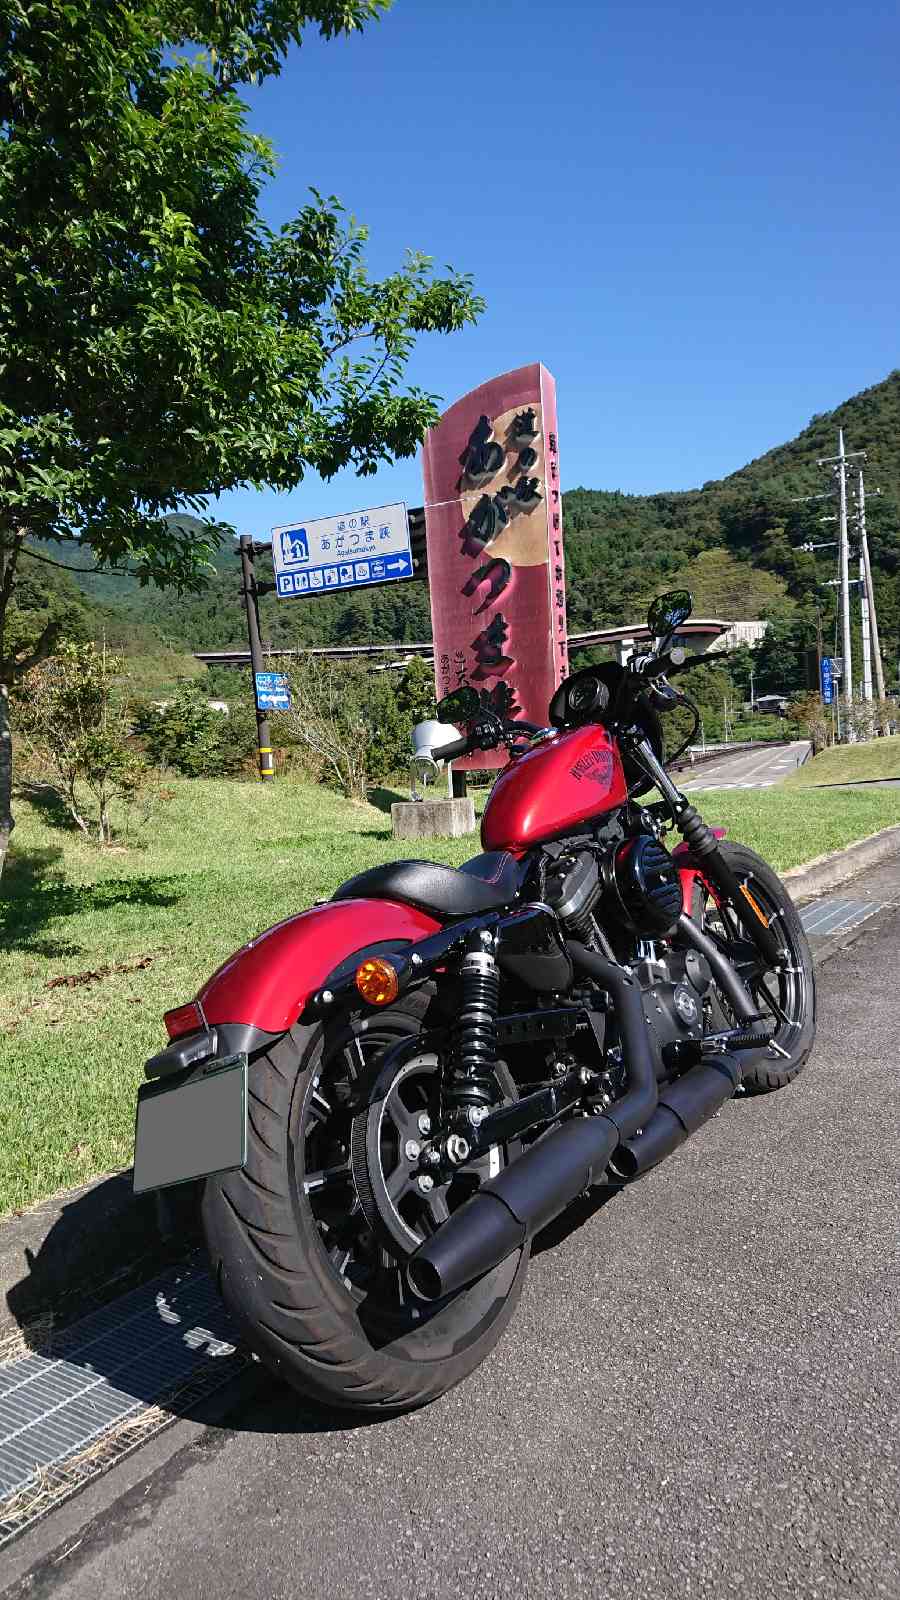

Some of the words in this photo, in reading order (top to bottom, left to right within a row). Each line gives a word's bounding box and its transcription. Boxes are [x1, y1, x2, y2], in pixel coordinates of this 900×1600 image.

[337, 515, 369, 532] 道の駅
[320, 526, 391, 551] あがつま峡
